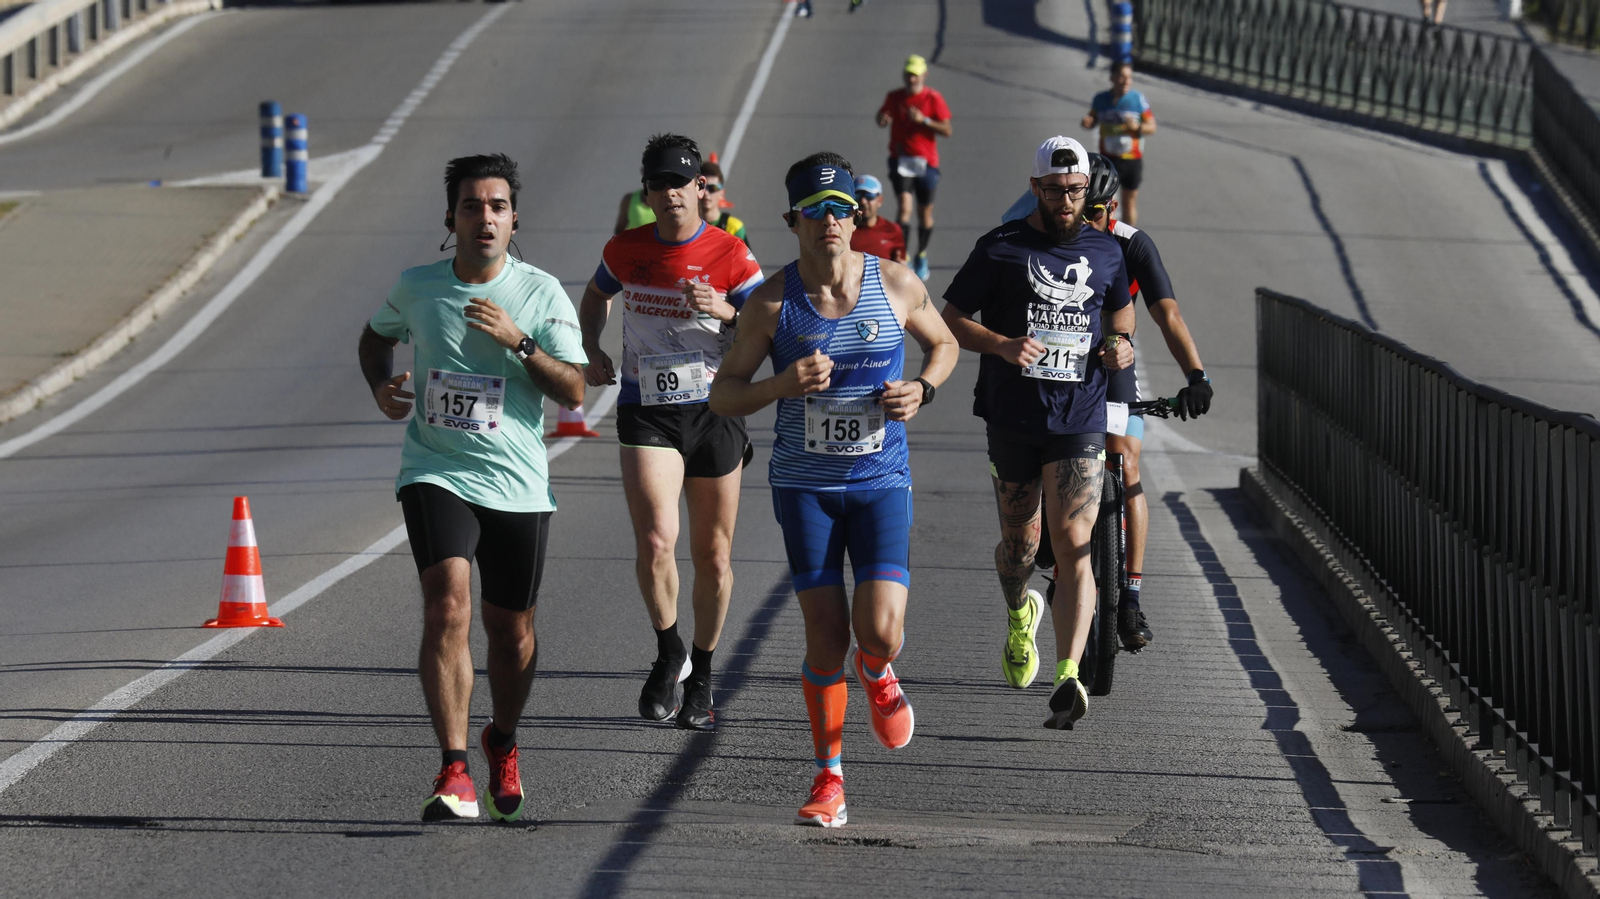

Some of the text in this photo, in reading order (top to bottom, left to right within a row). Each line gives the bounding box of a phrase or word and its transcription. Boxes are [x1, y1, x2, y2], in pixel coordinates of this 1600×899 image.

[631, 291, 682, 307] RUNNING
[634, 305, 693, 320] ALGECIRAS
[1037, 303, 1057, 312] MEDIA
[1027, 309, 1090, 326] MARATÓN
[1037, 347, 1070, 369] 211
[831, 362, 859, 371] tismo
[656, 371, 679, 393] 69
[1040, 370, 1072, 379] EVOS
[440, 391, 479, 418] 157
[656, 393, 691, 403] EVOS
[442, 418, 480, 431] EVOS
[821, 418, 860, 442] 158
[824, 445, 864, 453] EVOS
